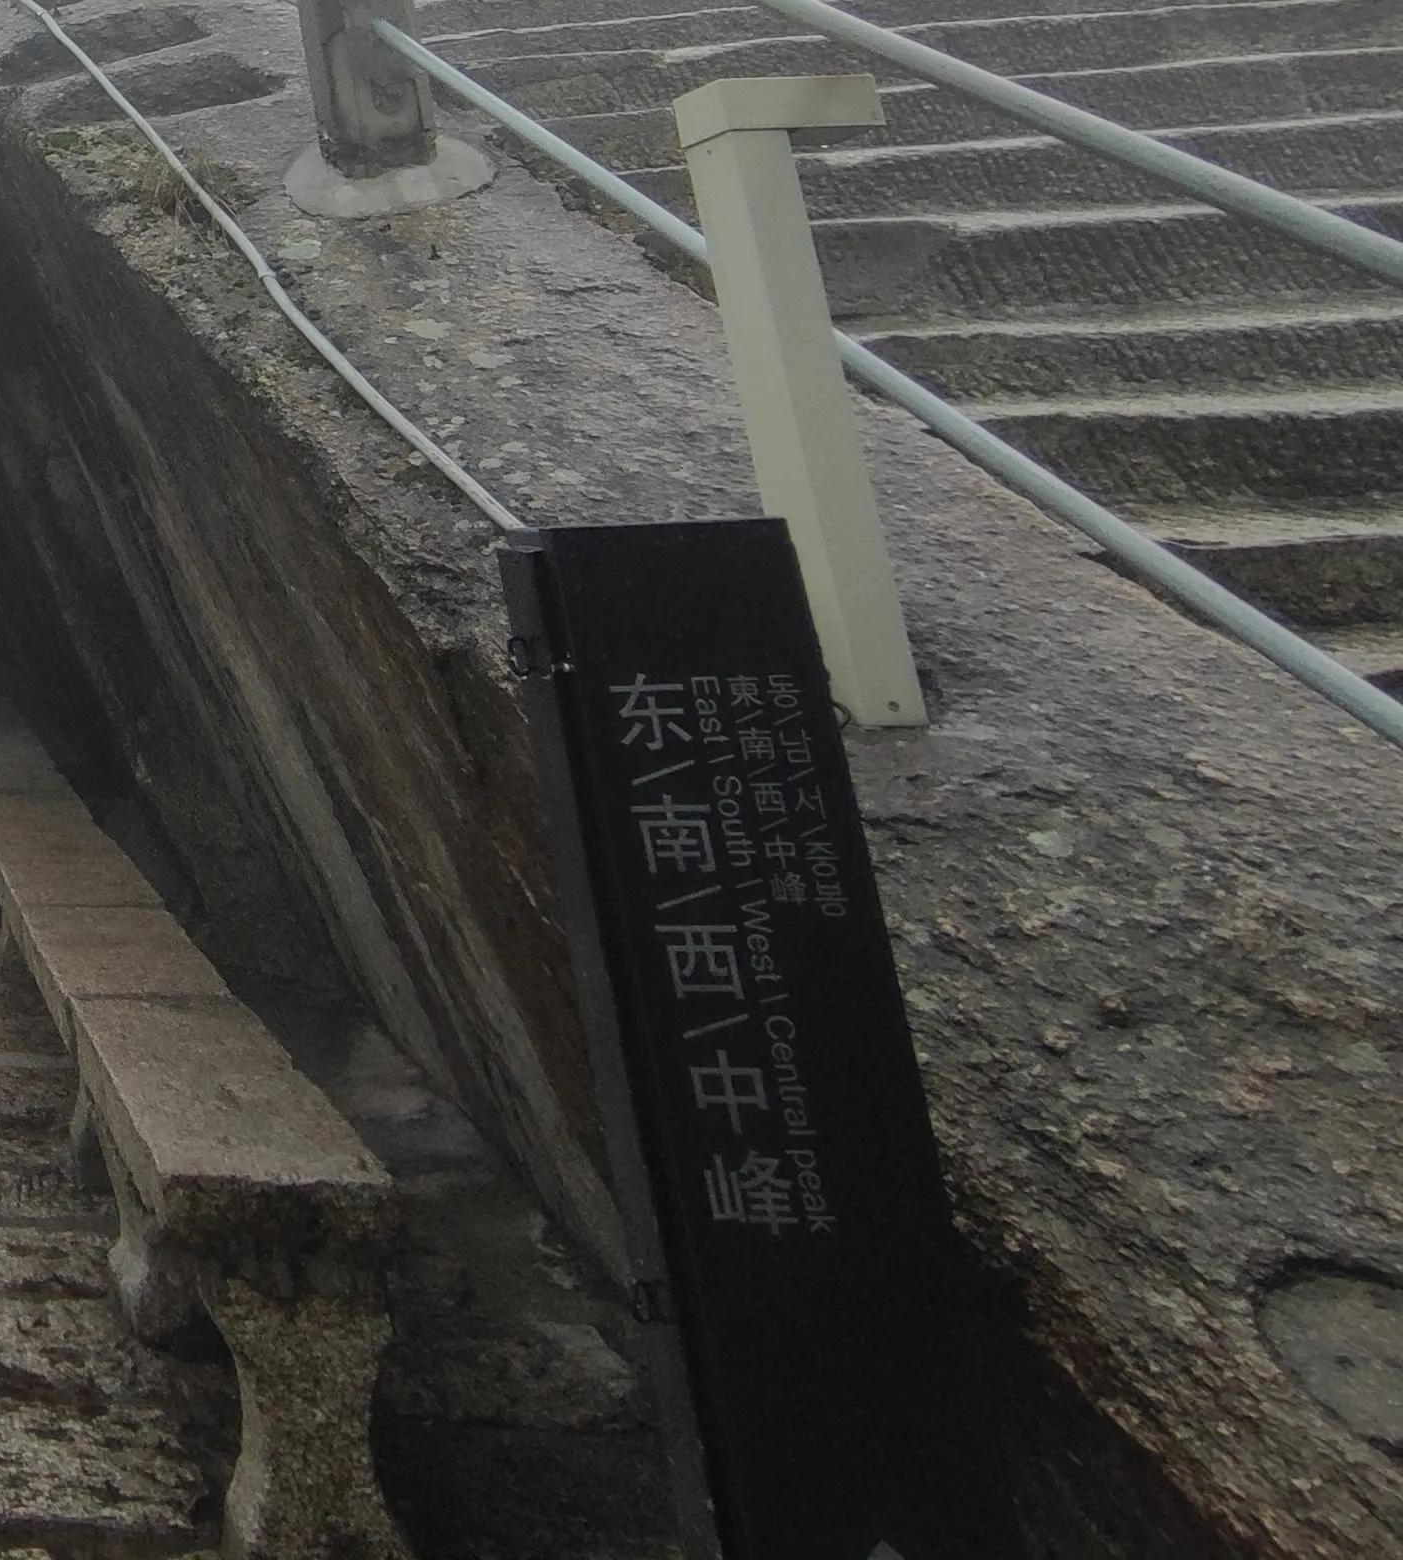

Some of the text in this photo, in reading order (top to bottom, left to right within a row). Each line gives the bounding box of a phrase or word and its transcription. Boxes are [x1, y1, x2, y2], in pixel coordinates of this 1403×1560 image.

[690, 675, 837, 1233] East South West Central peak
